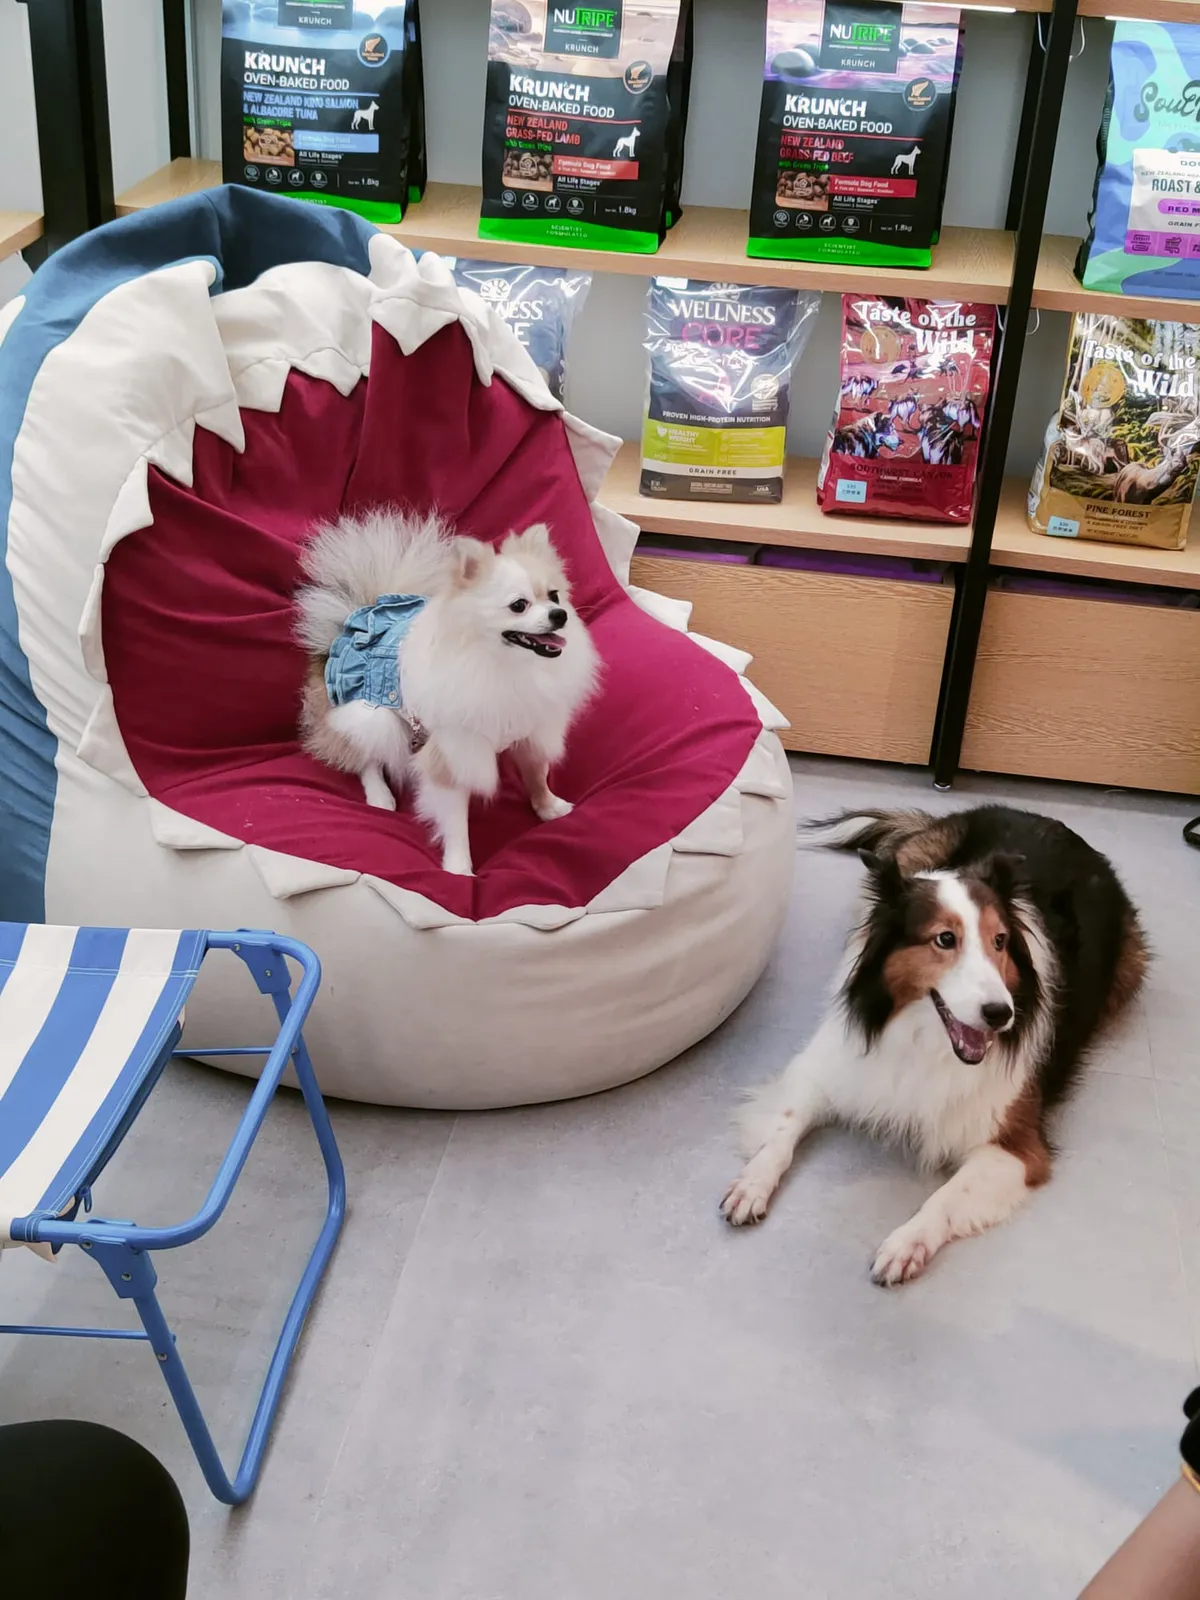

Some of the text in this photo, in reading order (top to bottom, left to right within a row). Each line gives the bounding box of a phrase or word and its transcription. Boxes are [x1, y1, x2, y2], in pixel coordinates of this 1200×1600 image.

[298, 15, 332, 26] KRUNCH
[553, 7, 615, 28] NUTRIPE
[829, 22, 893, 43] NUTRIPE
[564, 43, 599, 54] KRUNCH
[244, 50, 326, 76] KRUNCH
[841, 58, 876, 69] KRUNCH
[243, 72, 350, 91] OVEN-BAKED FOOD
[509, 74, 591, 102] KRUNCH
[243, 91, 262, 102] NEW
[263, 94, 303, 107] ZEALAND
[324, 98, 359, 110] SALMON
[508, 95, 615, 119] OVEN-BAKED FOOD
[784, 93, 867, 118] KRUNCH
[250, 104, 294, 118] ALBACORE
[296, 107, 319, 121] TUNA
[507, 114, 569, 132] NEW ZEALAND
[782, 115, 893, 134] OVEN-BAKED FOOD
[505, 127, 581, 145] GRASS-FED LAMB
[781, 135, 845, 150] NEW ZEALAND
[1152, 178, 1192, 193] ROAST
[1168, 206, 1189, 214] RED
[1168, 220, 1193, 228] GRAIN
[667, 299, 776, 326] WELLNESS
[857, 301, 912, 324] Taste
[944, 308, 977, 328] the
[681, 321, 762, 350] CORE
[915, 328, 976, 355] Wild
[1086, 340, 1197, 371] Taste of the
[1135, 369, 1195, 398] Wild
[662, 410, 689, 420] PROVEN
[736, 415, 771, 424] NUTRITION
[689, 467, 715, 475] GRAIN
[1085, 504, 1152, 519] PINE FOREST
